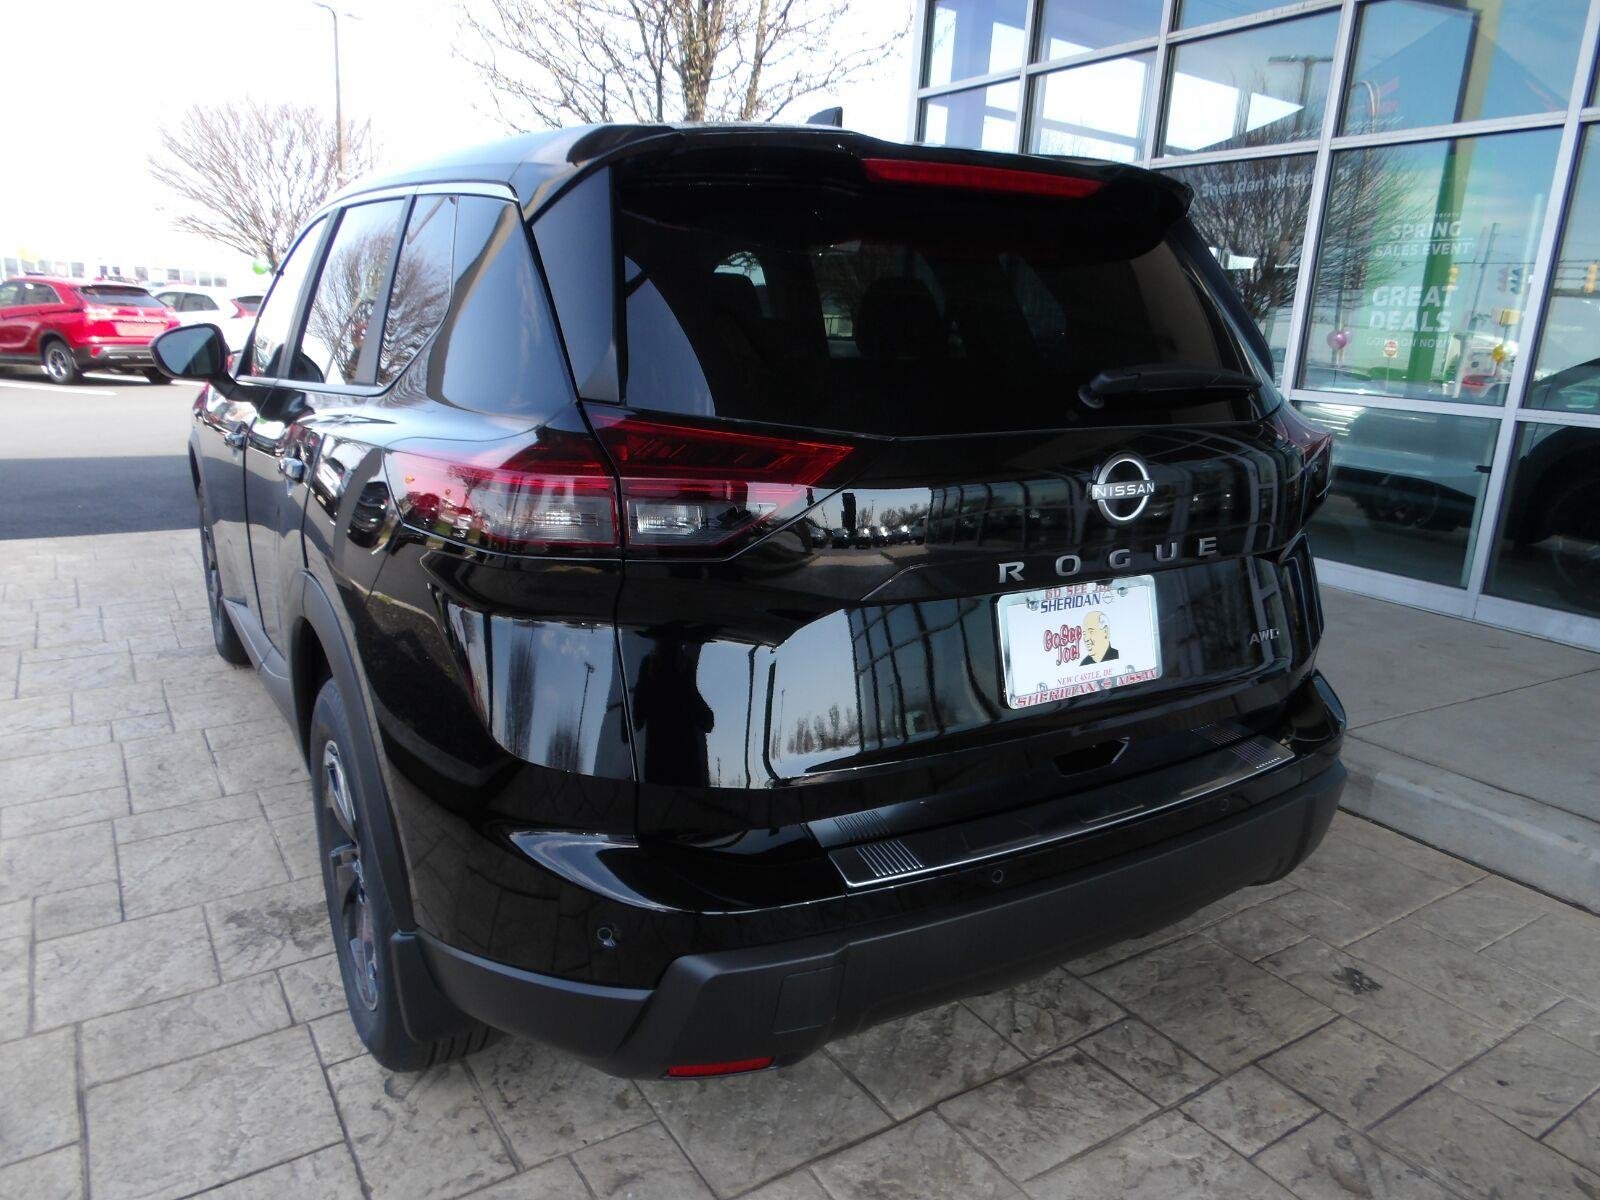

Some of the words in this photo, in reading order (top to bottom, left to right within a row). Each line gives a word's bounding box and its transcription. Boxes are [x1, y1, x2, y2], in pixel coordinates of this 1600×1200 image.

[1201, 178, 1265, 197] Sheridan
[1390, 221, 1462, 240] SPRING
[1374, 243, 1418, 257] SALES
[1422, 242, 1472, 256] EVENT
[1373, 286, 1458, 307] GREAT
[1369, 311, 1452, 332] DEALS
[1094, 482, 1155, 498] NISSAN
[998, 537, 1217, 584] ROGUE
[1066, 585, 1088, 596] SEE
[1040, 593, 1101, 613] SHERIDAN
[1248, 628, 1281, 646] AWD
[1056, 677, 1073, 687] NEW
[1074, 671, 1102, 684] CASTLE,
[1102, 668, 1113, 677] DE
[1016, 682, 1096, 707] SHERIDAN
[1117, 670, 1157, 686] NISSAN
